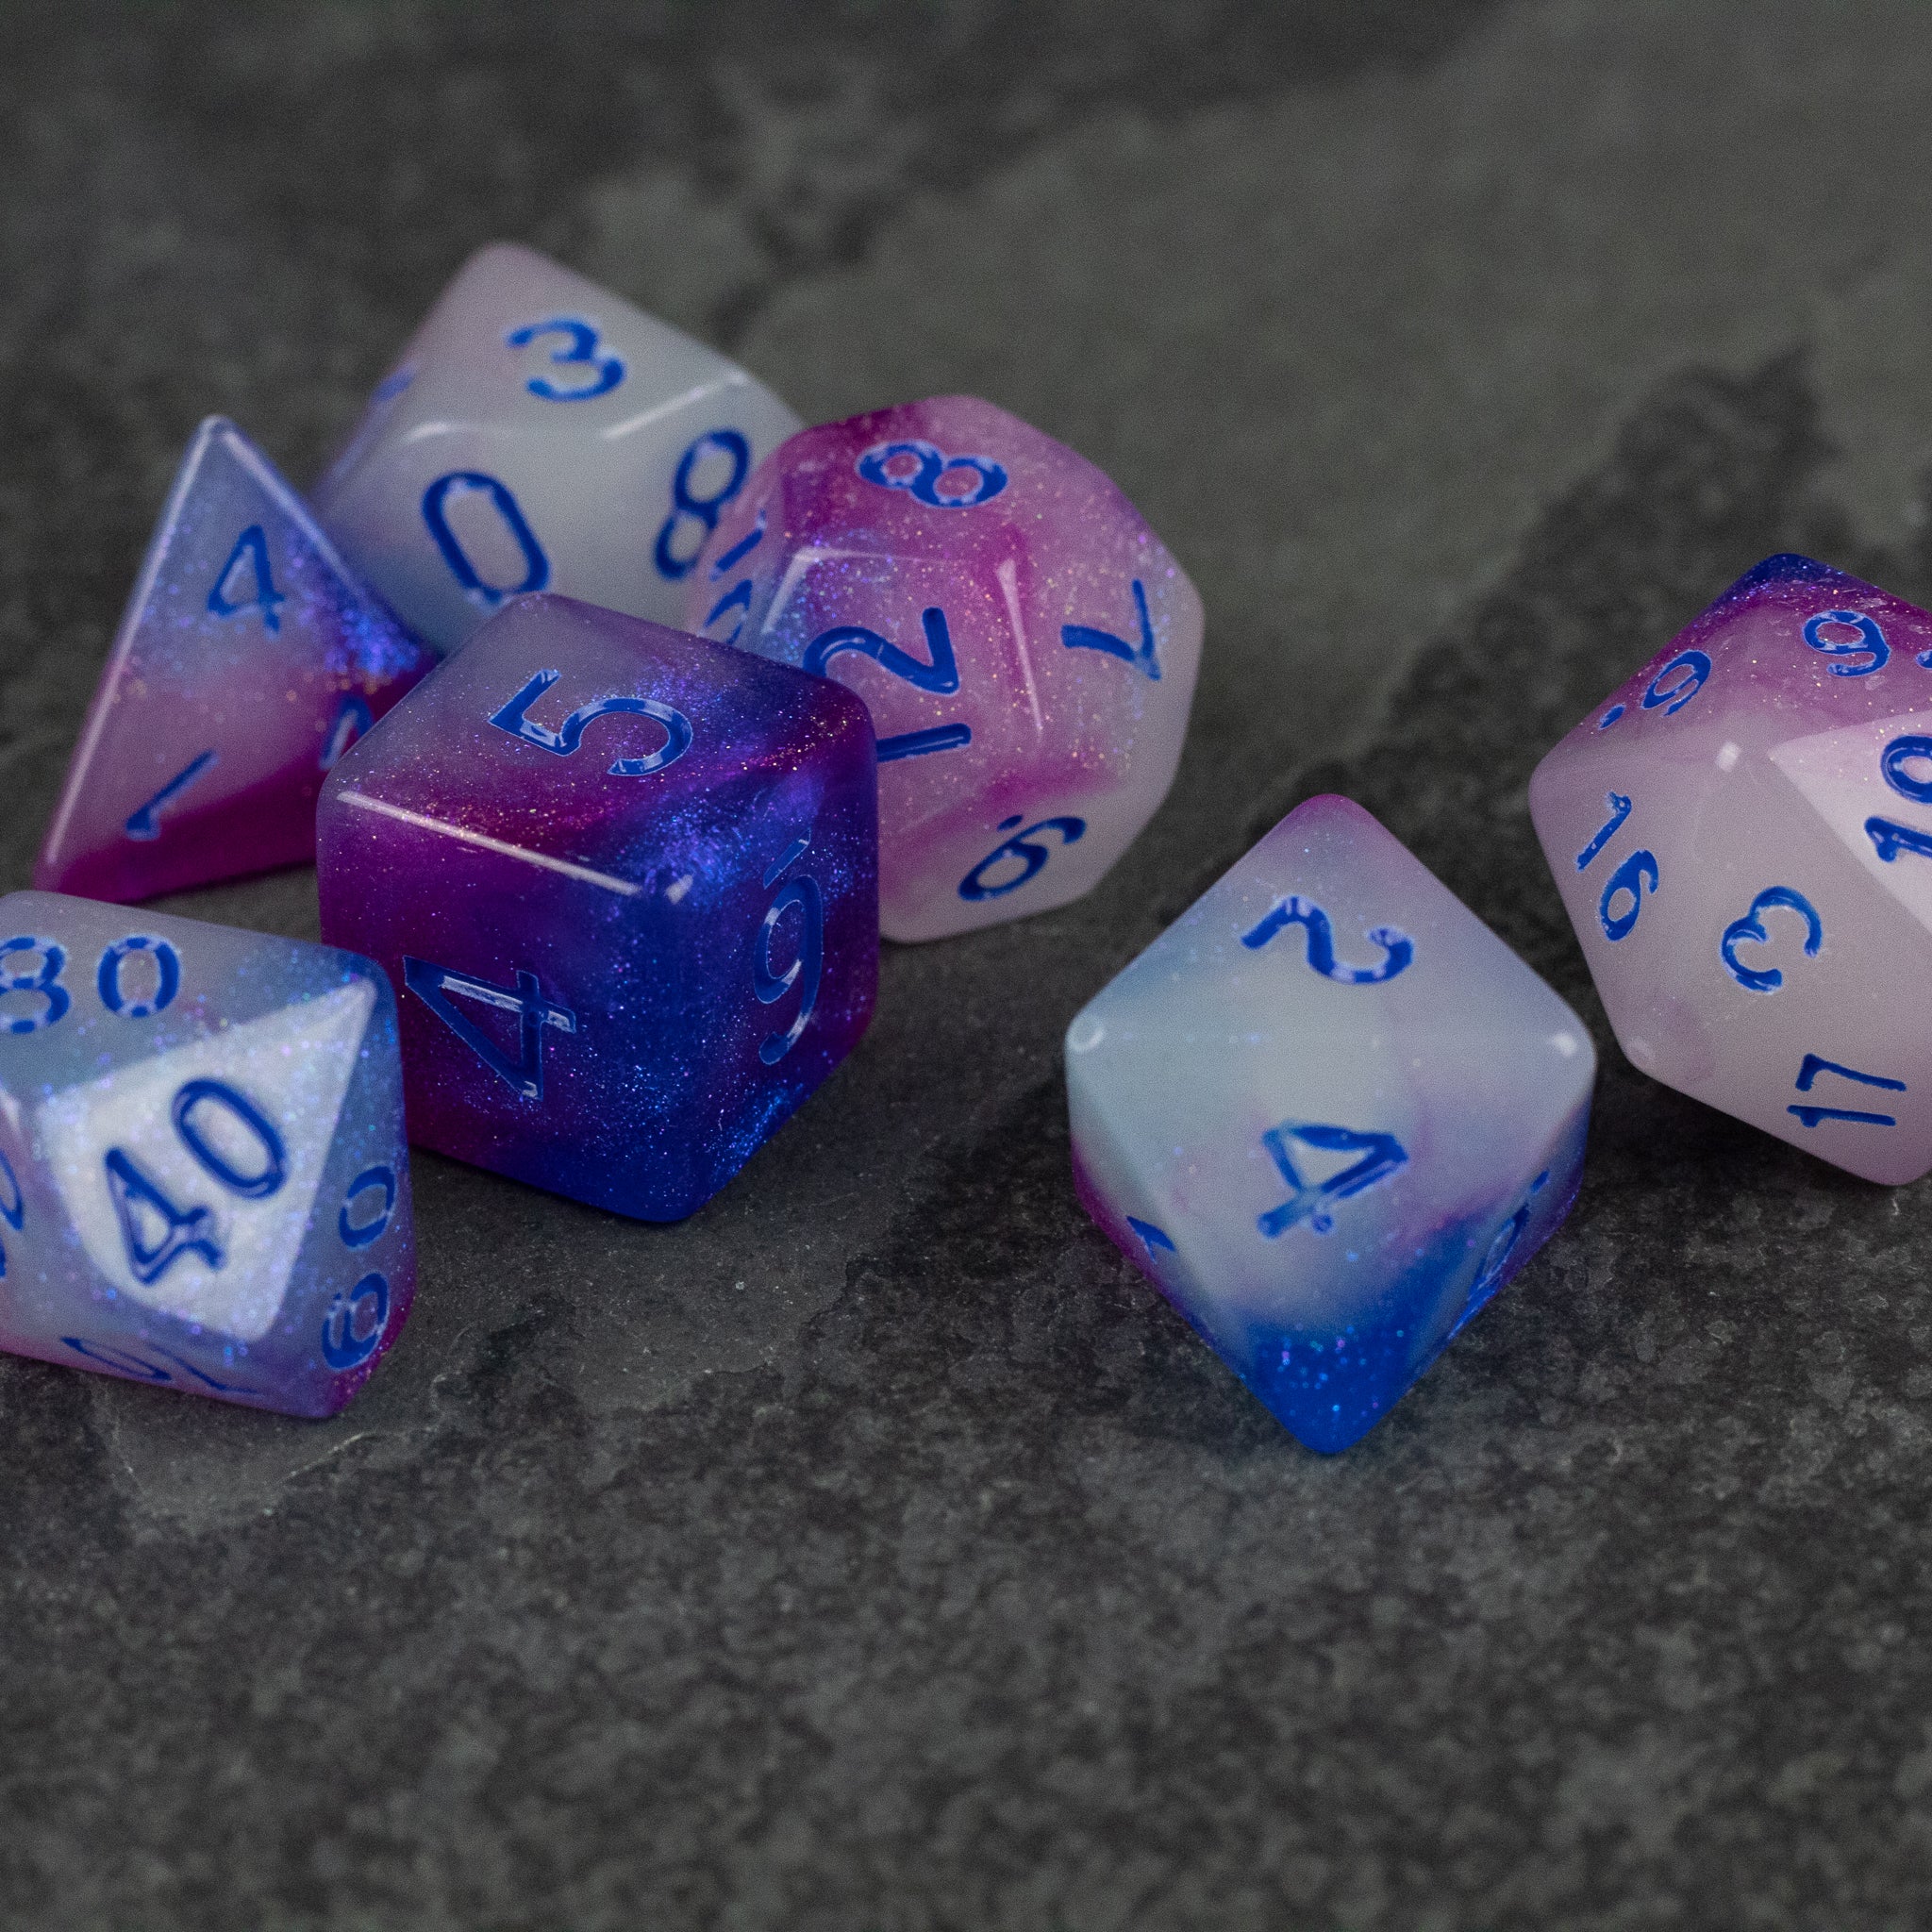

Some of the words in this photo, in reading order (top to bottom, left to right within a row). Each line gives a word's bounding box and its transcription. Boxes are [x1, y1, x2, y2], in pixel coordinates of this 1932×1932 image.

[508, 318, 626, 402] 3
[654, 428, 750, 581] 8
[855, 439, 1009, 508] 8
[206, 524, 286, 639] 4
[419, 471, 552, 610] 0
[1060, 577, 1162, 682] 7
[488, 668, 693, 777] 5
[803, 606, 973, 763] 12
[124, 750, 220, 840] 1
[1574, 791, 1660, 942] 16
[0, 934, 181, 1036] 80
[1240, 894, 1415, 986] 2
[1720, 885, 1824, 993] 3
[403, 955, 577, 1102] 4
[1787, 1053, 1907, 1129] 17
[103, 1076, 290, 1289] 40
[1257, 1119, 1410, 1241] 4
